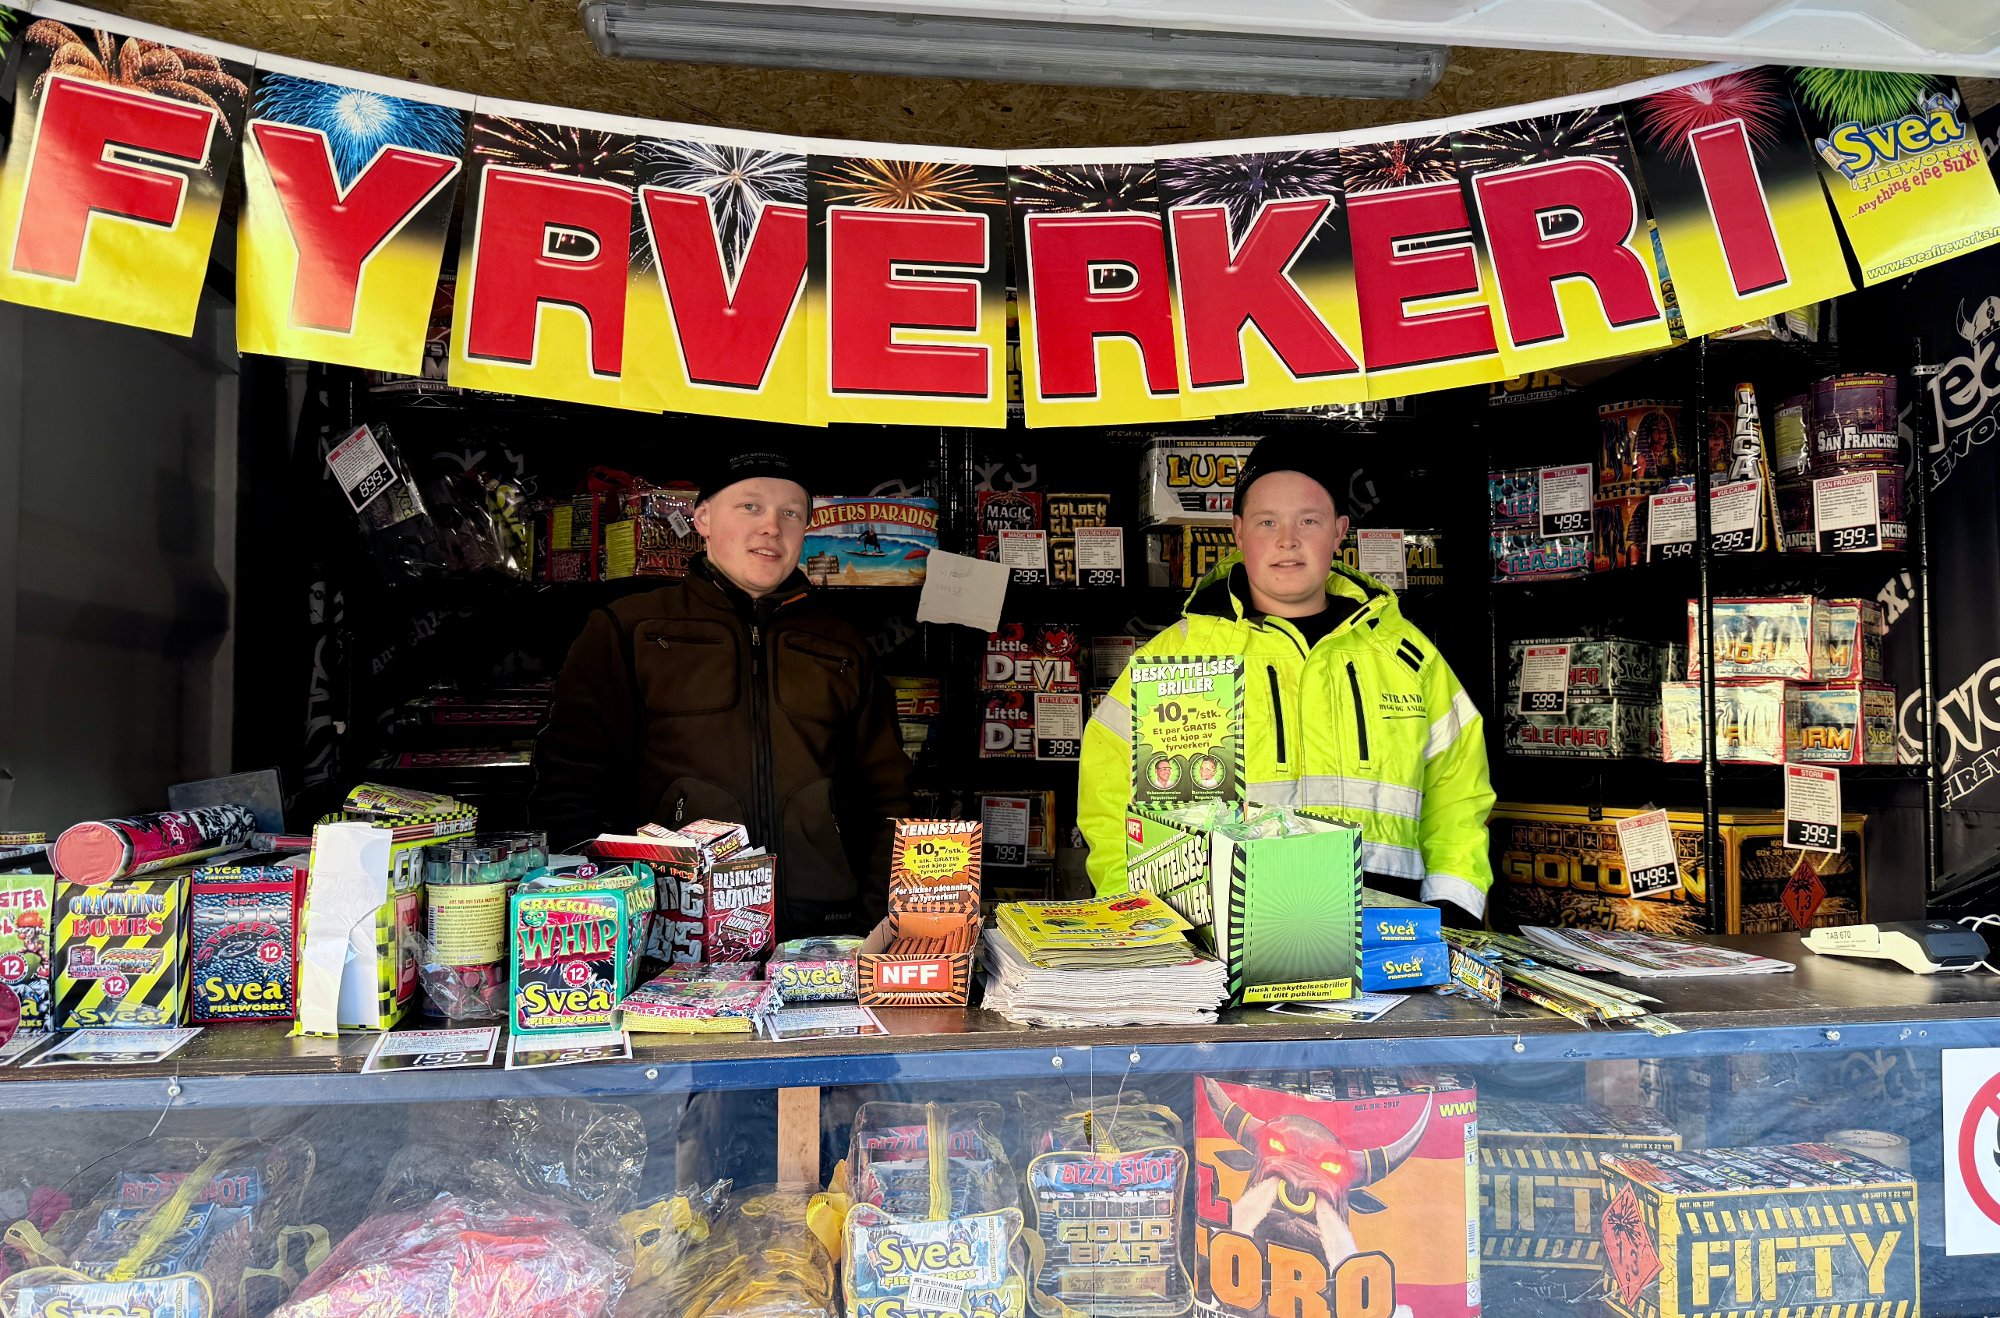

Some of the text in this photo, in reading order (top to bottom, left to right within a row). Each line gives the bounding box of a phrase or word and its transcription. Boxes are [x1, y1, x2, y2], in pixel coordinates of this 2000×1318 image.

[1831, 111, 1967, 172] Svea
[1857, 141, 1974, 191] FIREWORKS
[1913, 166, 1943, 188] else
[10, 71, 1791, 404] FYRVERKERI
[1817, 425, 1899, 452] SAN FRANCISCO
[1554, 469, 1577, 477] TEASER
[1717, 486, 1748, 496] VULCANO
[1819, 476, 1872, 490] SAN FRANCISCO
[1662, 495, 1694, 505] SOFT SKY
[870, 503, 939, 530] PARADISE
[987, 505, 1031, 519] MAGIC
[1050, 502, 1106, 517] GOLDEN
[986, 519, 1013, 533] MIX
[1553, 513, 1590, 530] 499.-
[1711, 532, 1752, 551] 299.-
[1833, 528, 1876, 549] 399.-
[1506, 549, 1587, 574] TEASER
[1013, 569, 1046, 584] 299.-
[1088, 569, 1121, 584] 299.-
[1407, 575, 1443, 586] EDITION
[986, 641, 1029, 653] Little
[1132, 658, 1239, 684] BESKYTTELSES-
[1157, 678, 1214, 697] BRILLER
[1381, 692, 1423, 704] STRAND
[985, 708, 1028, 720] Little
[1165, 726, 1181, 736] par
[1183, 722, 1217, 732] GRATIS
[1048, 739, 1080, 755] 399.-
[1801, 770, 1824, 778] STORM
[900, 821, 977, 837] TENNSTAV
[1799, 823, 1837, 845] 399.-
[715, 838, 739, 855] Svea
[1632, 866, 1675, 887] 4499.-
[69, 894, 166, 917] CRACKLING
[519, 899, 618, 920] CRACKLING
[197, 907, 289, 925] SUN
[72, 916, 164, 937] BOMBS
[1379, 921, 1416, 936] Svea
[1825, 930, 1852, 940] TAB 670
[197, 921, 281, 961] STREET
[517, 918, 620, 968] WHIP
[751, 931, 762, 944] 12
[264, 947, 278, 959] 12
[2, 959, 22, 973] 12
[569, 967, 586, 981] 12
[882, 964, 939, 985] NFF
[1385, 959, 1422, 975] Svea
[782, 964, 843, 987] Svea
[108, 979, 123, 992] 12
[205, 977, 284, 1003] Svea
[1248, 980, 1349, 995] Husk beskyttelsesbriller
[524, 984, 611, 1015] Svea
[1262, 988, 1332, 1001] til ditt publikum!
[78, 1008, 169, 1024] Svea
[209, 1003, 287, 1013] FIREWORKS
[1062, 1158, 1174, 1185] BIZZI SHOT
[1058, 1220, 1171, 1242] GOLD
[877, 1232, 977, 1273] Svea
[1070, 1242, 1160, 1264] BAR
[1691, 1231, 1902, 1306] FIFTY
